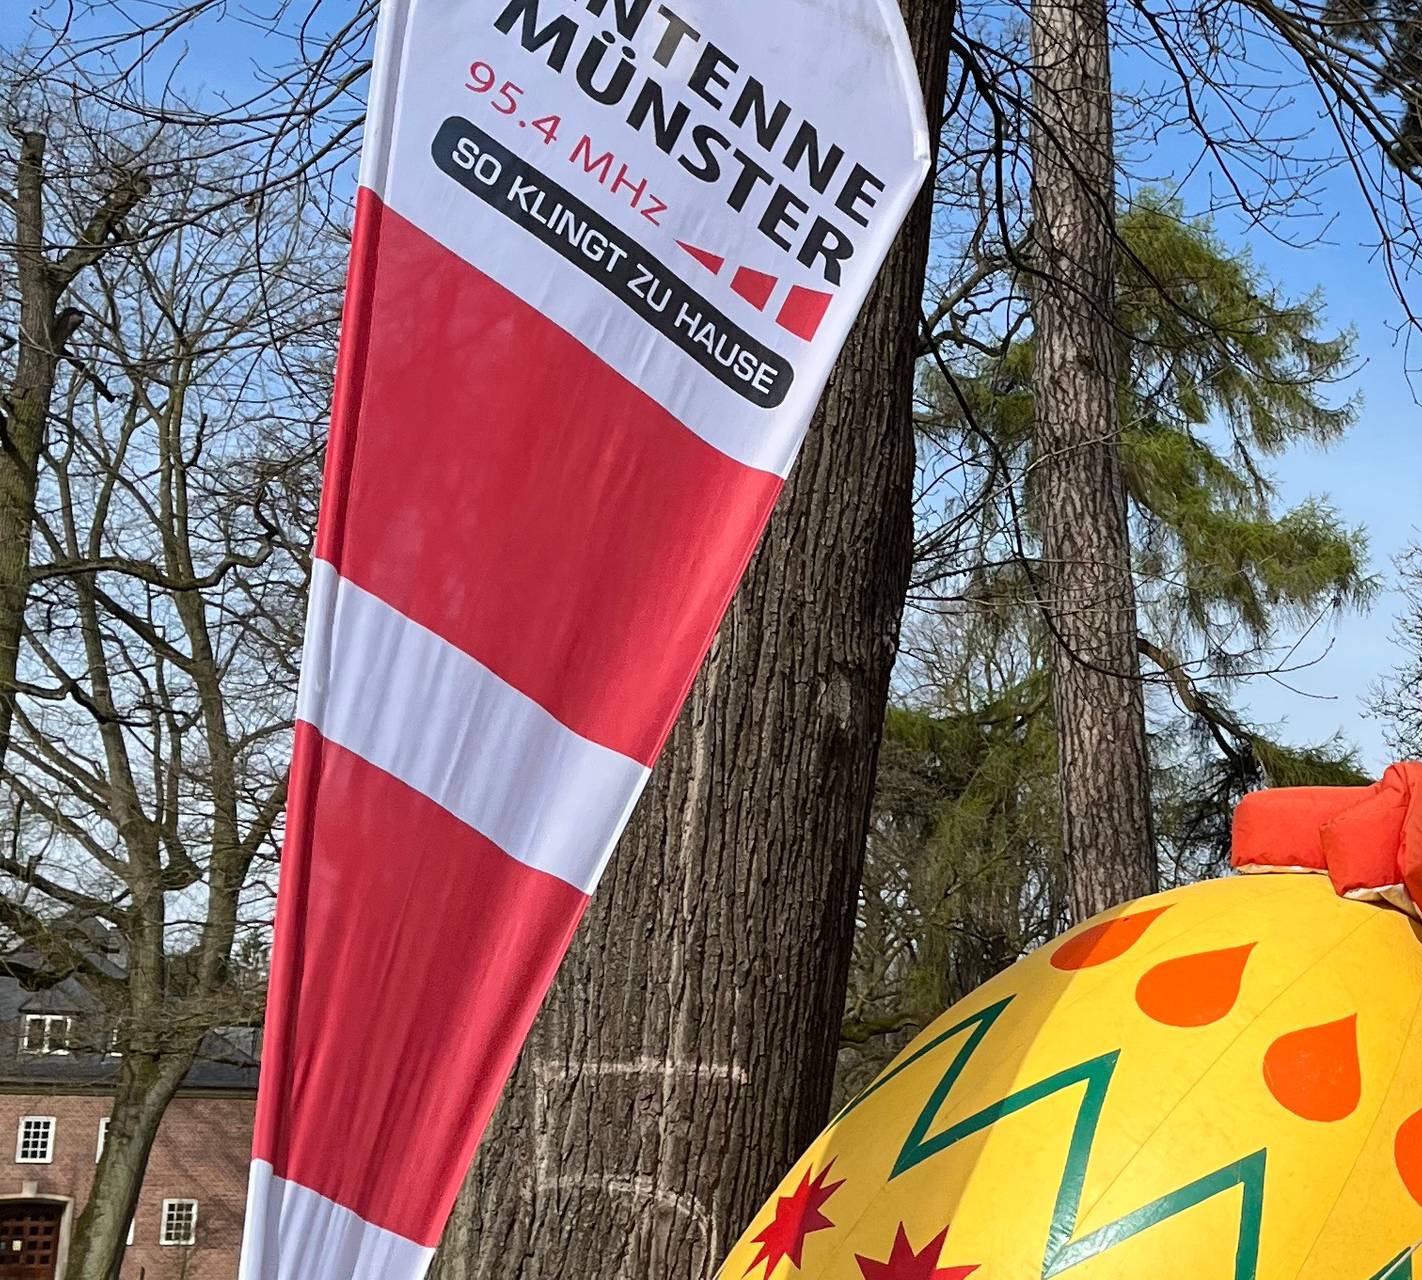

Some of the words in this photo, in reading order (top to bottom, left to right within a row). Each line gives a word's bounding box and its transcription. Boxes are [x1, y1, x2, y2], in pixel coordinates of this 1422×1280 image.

[465, 61, 562, 145] 95.4
[568, 135, 669, 227] MHz
[493, 0, 855, 287] MÜNSTER
[574, 0, 886, 228] NTENNE
[451, 136, 502, 187] SO
[507, 171, 628, 273] KLINGT
[626, 263, 672, 313] ZU
[673, 302, 779, 395] HAUSE
